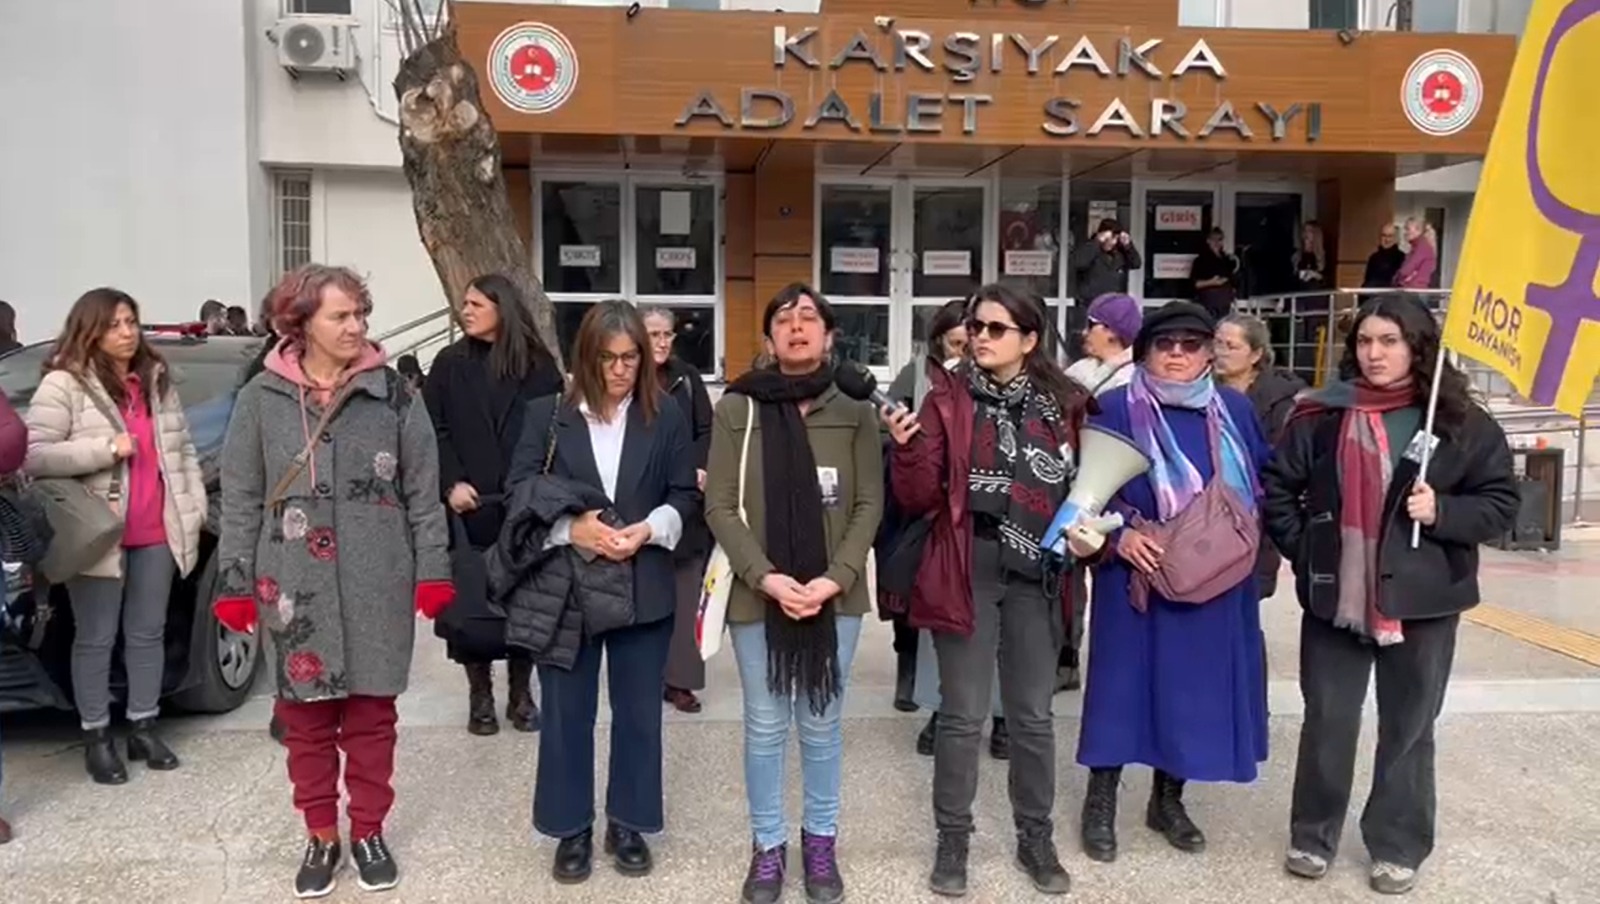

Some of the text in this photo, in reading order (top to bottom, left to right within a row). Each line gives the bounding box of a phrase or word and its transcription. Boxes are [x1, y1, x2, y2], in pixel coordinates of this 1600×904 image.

[773, 24, 1227, 82] KARŞIYAKA
[674, 89, 1322, 143] ADALET SARAYI
[1472, 284, 1522, 341] MOR
